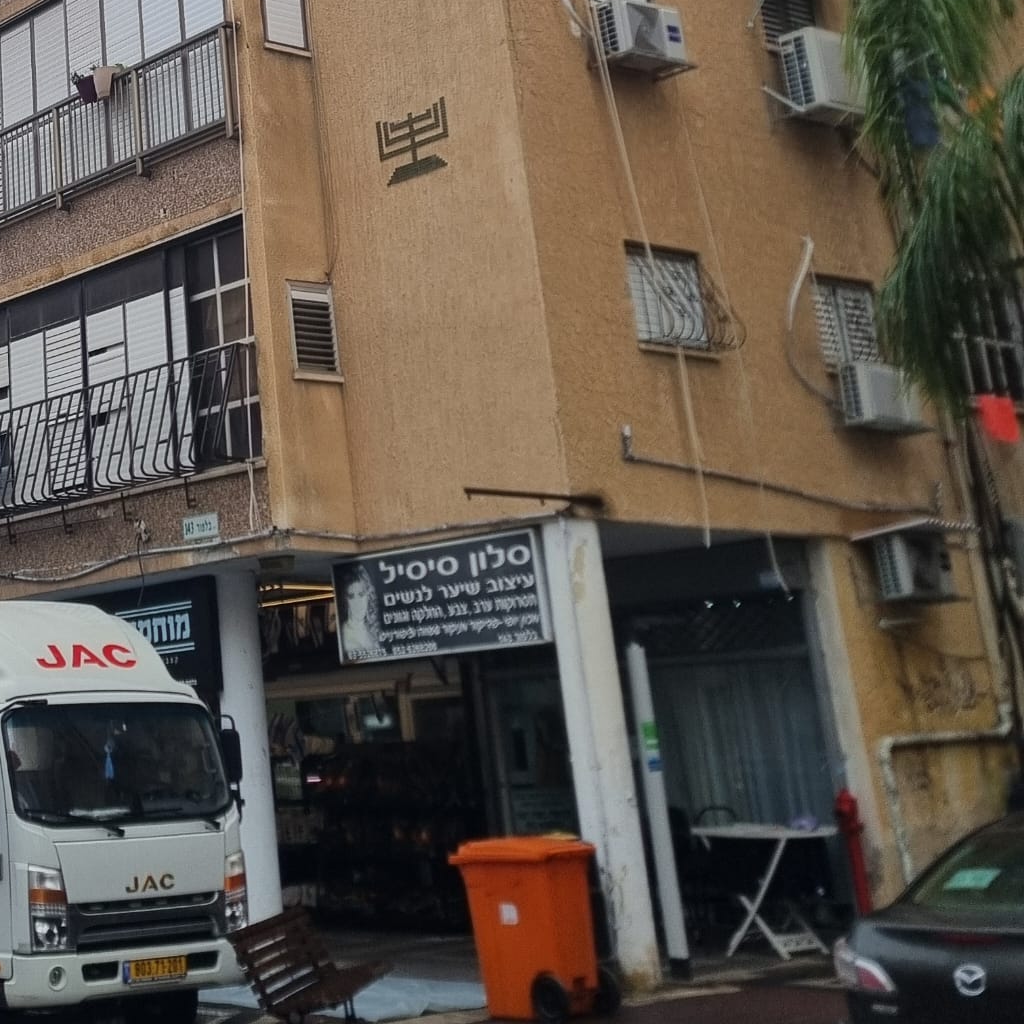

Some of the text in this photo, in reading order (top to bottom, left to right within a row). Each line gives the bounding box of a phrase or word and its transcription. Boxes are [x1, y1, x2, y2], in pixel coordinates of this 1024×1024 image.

[378, 544, 531, 584] סלון סיסיל
[383, 573, 535, 607] עיצוב שיער לנשים
[36, 644, 137, 669] JAC
[125, 874, 175, 893] JAC
